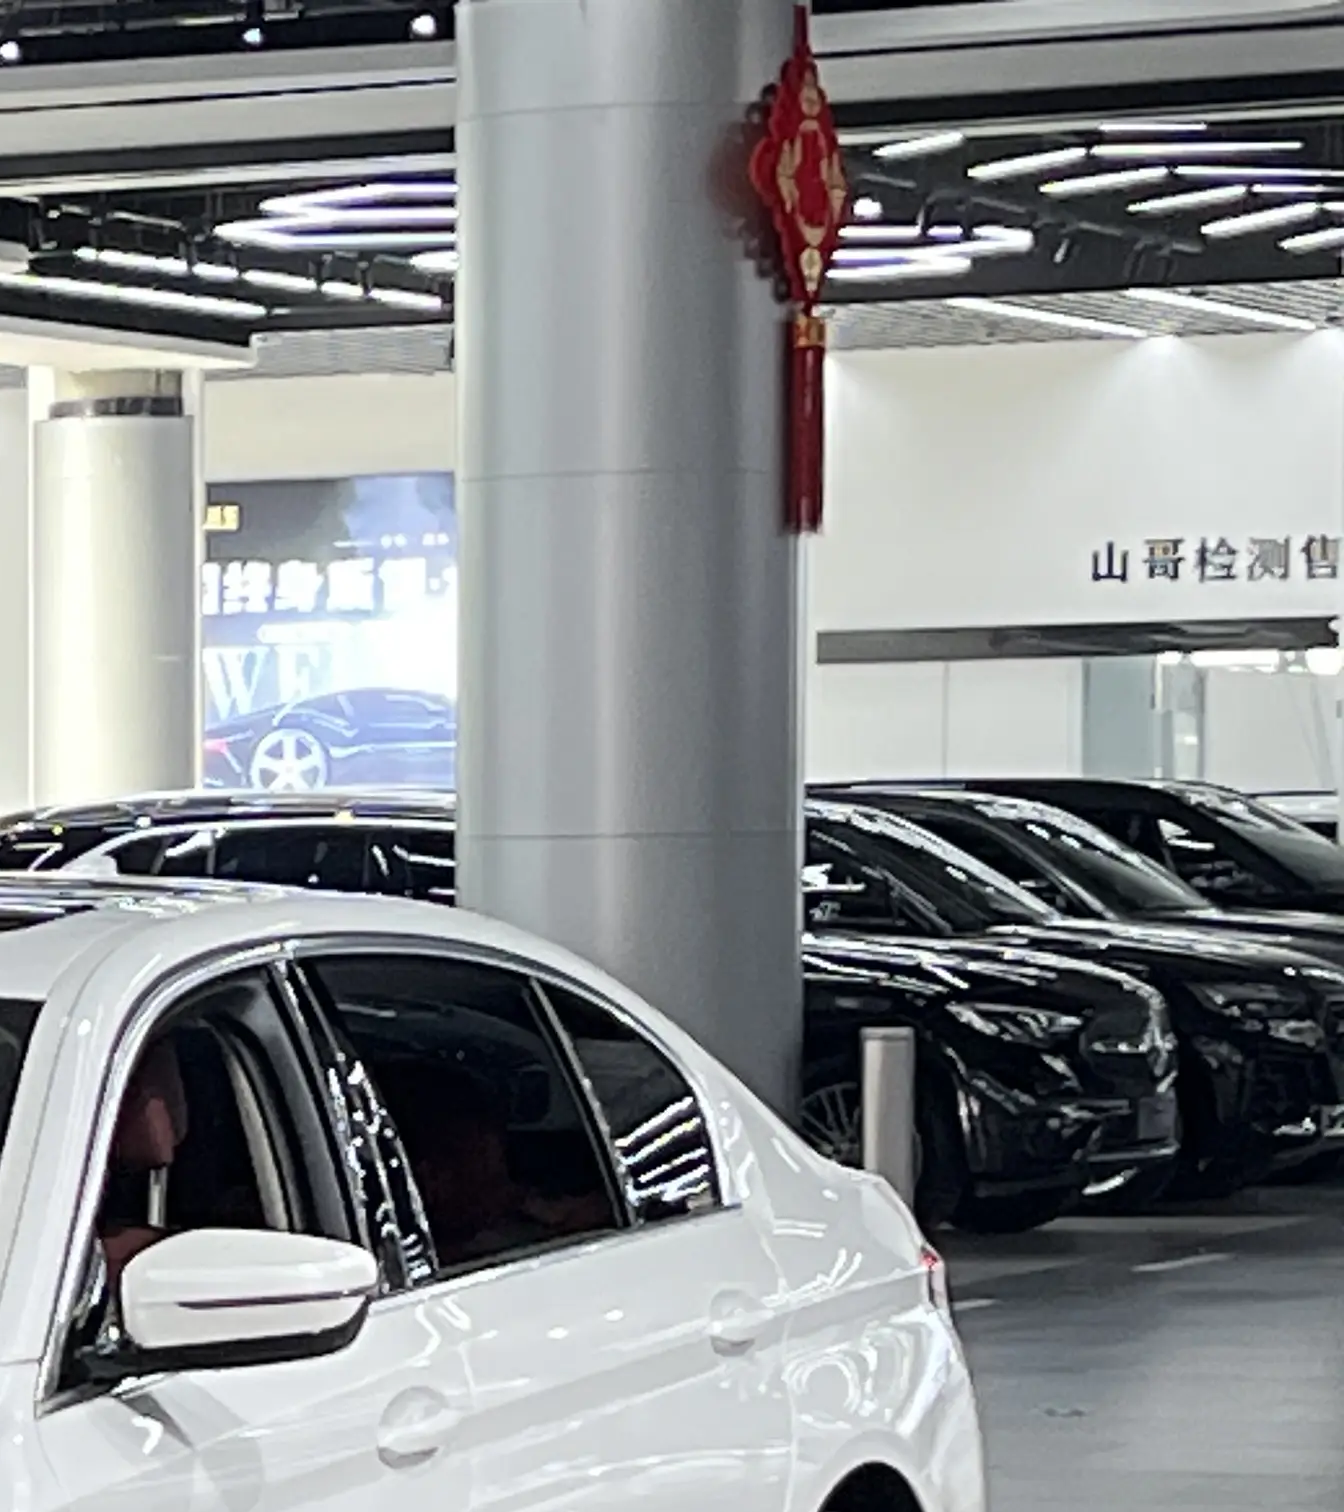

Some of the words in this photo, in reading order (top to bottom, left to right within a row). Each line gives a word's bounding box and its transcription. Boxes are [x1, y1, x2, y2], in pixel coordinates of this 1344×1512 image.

[1091, 533, 1343, 583] 山哥检测售
